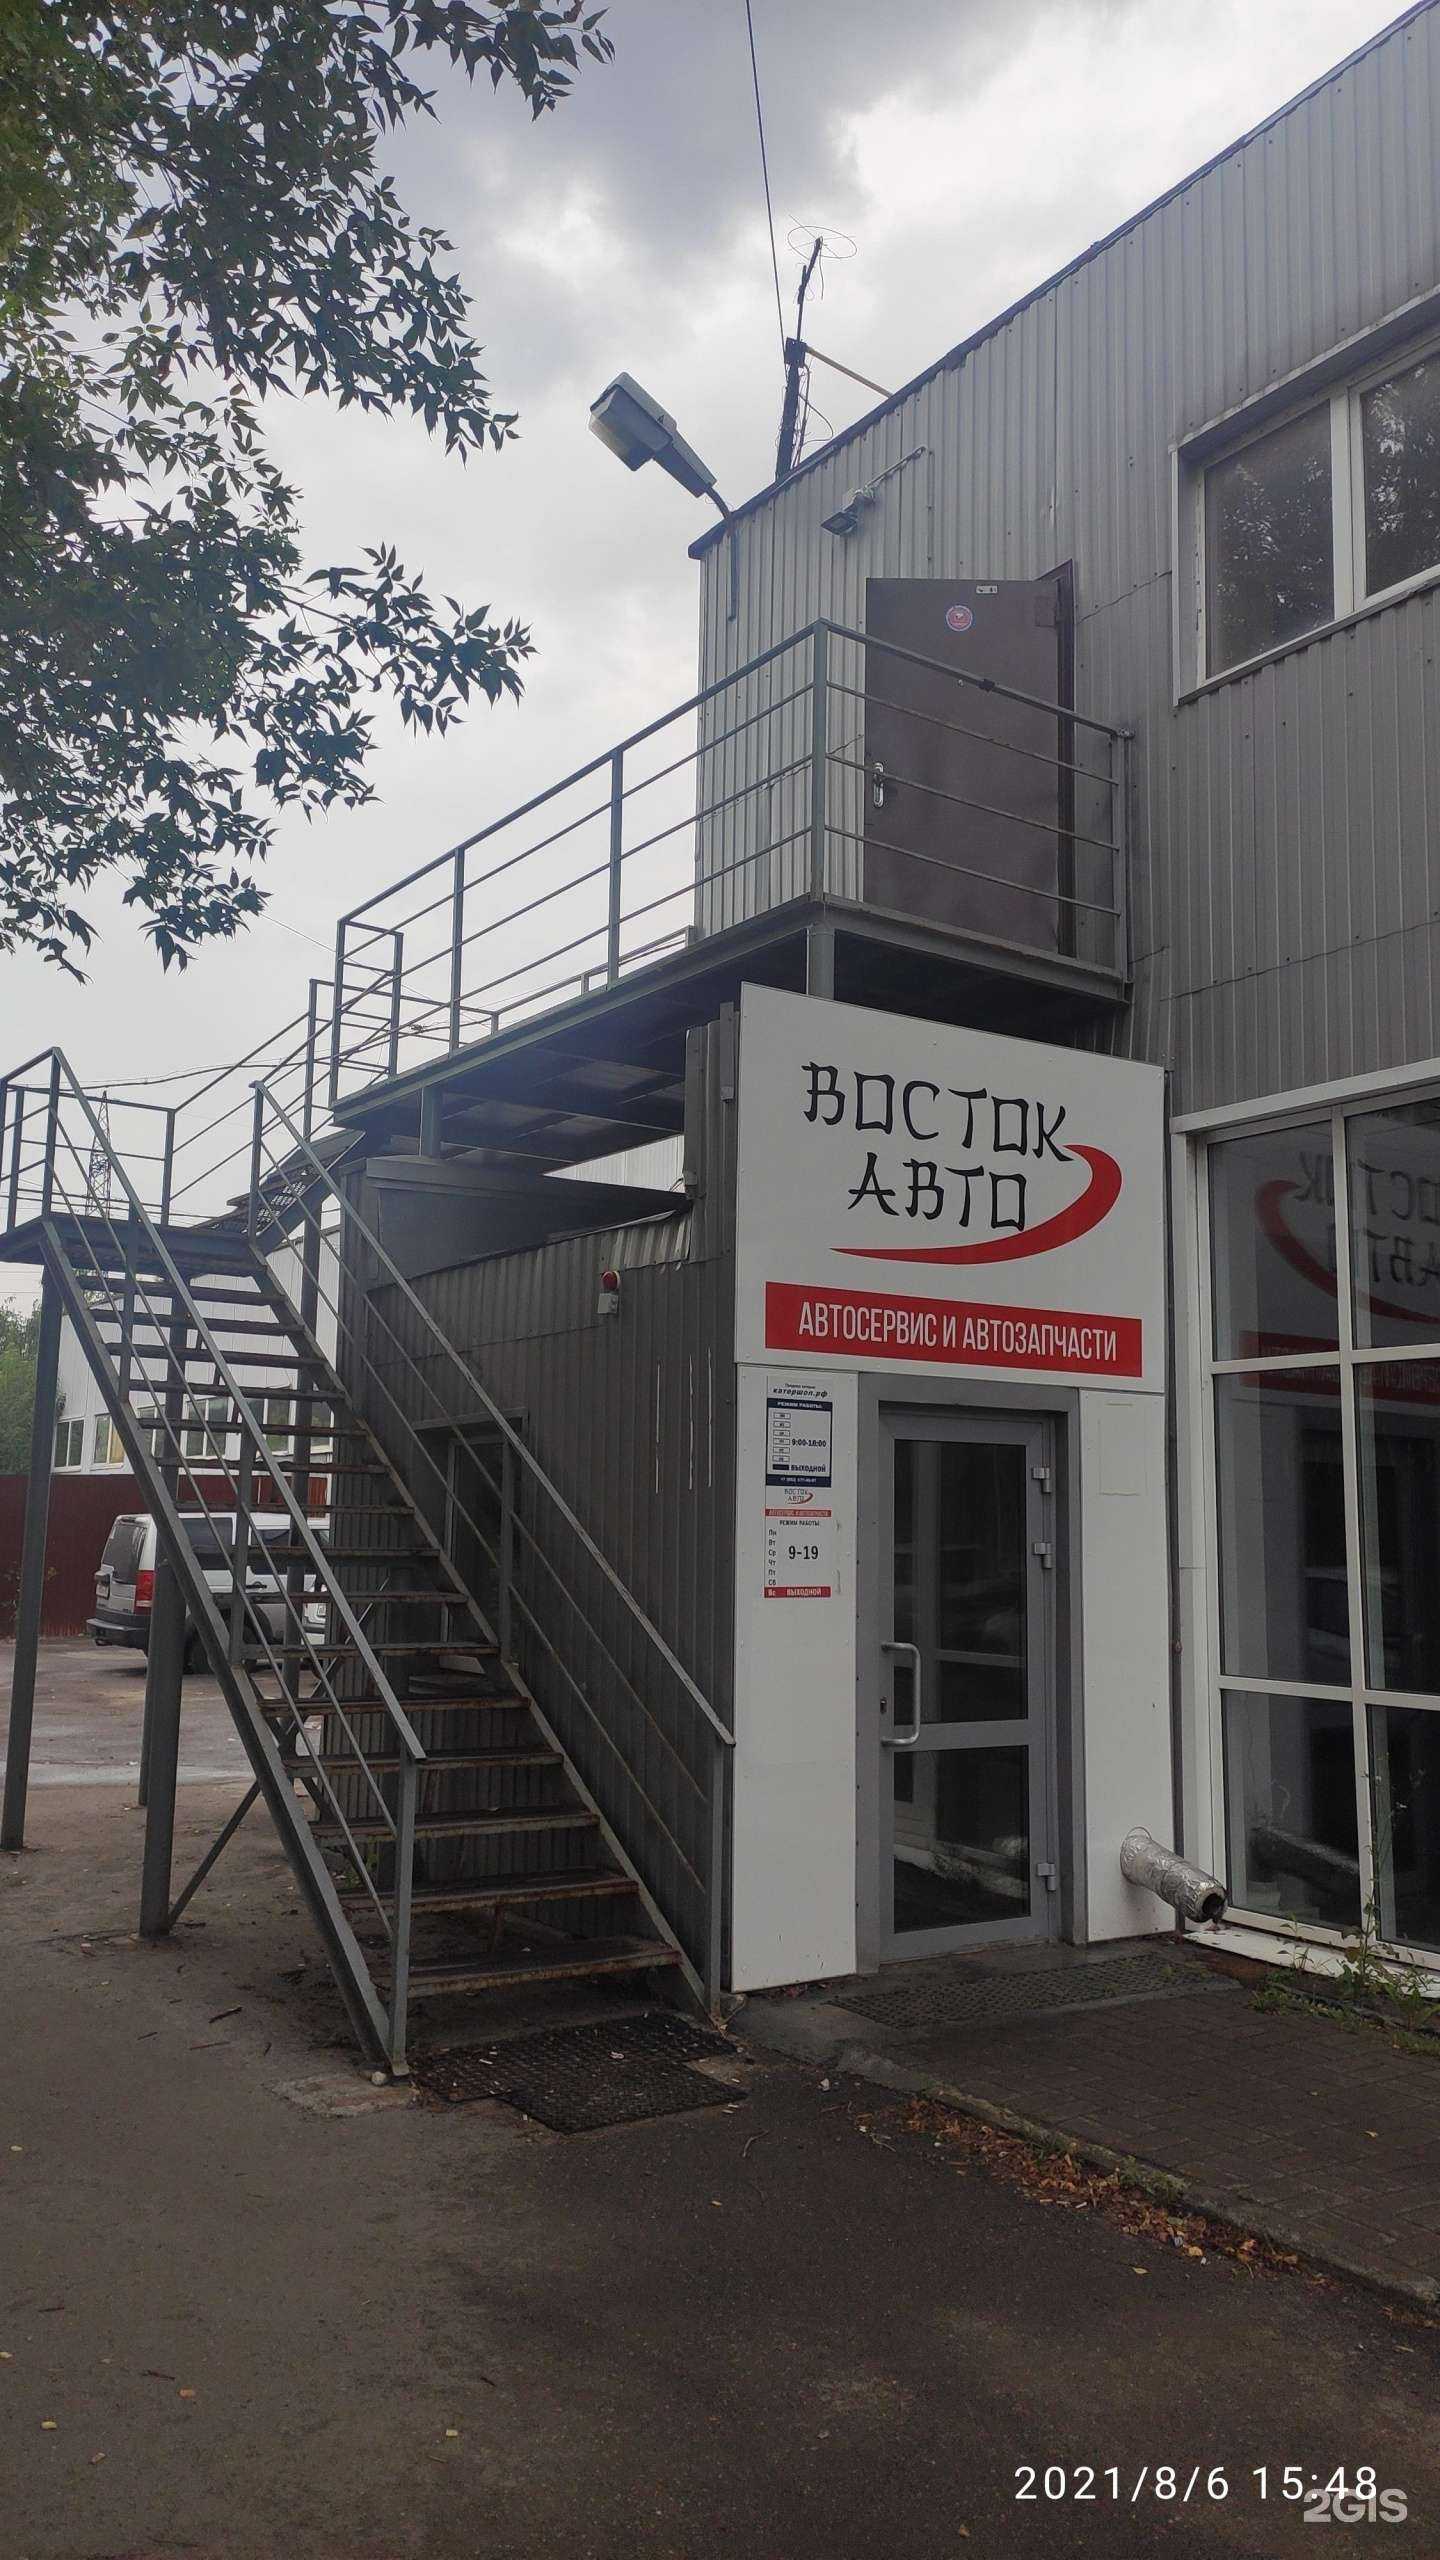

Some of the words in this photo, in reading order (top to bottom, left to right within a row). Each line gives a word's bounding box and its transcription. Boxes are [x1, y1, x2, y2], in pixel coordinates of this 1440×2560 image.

[801, 1061, 1074, 1162] ВОСТОК
[848, 1151, 1027, 1232] АВТО
[799, 1301, 937, 1348] АВТОСЕРВИС
[942, 1318, 957, 1348] И
[962, 1319, 1117, 1362] АВТОЗАПЧАСТИ
[788, 1545, 819, 1560] 9-19
